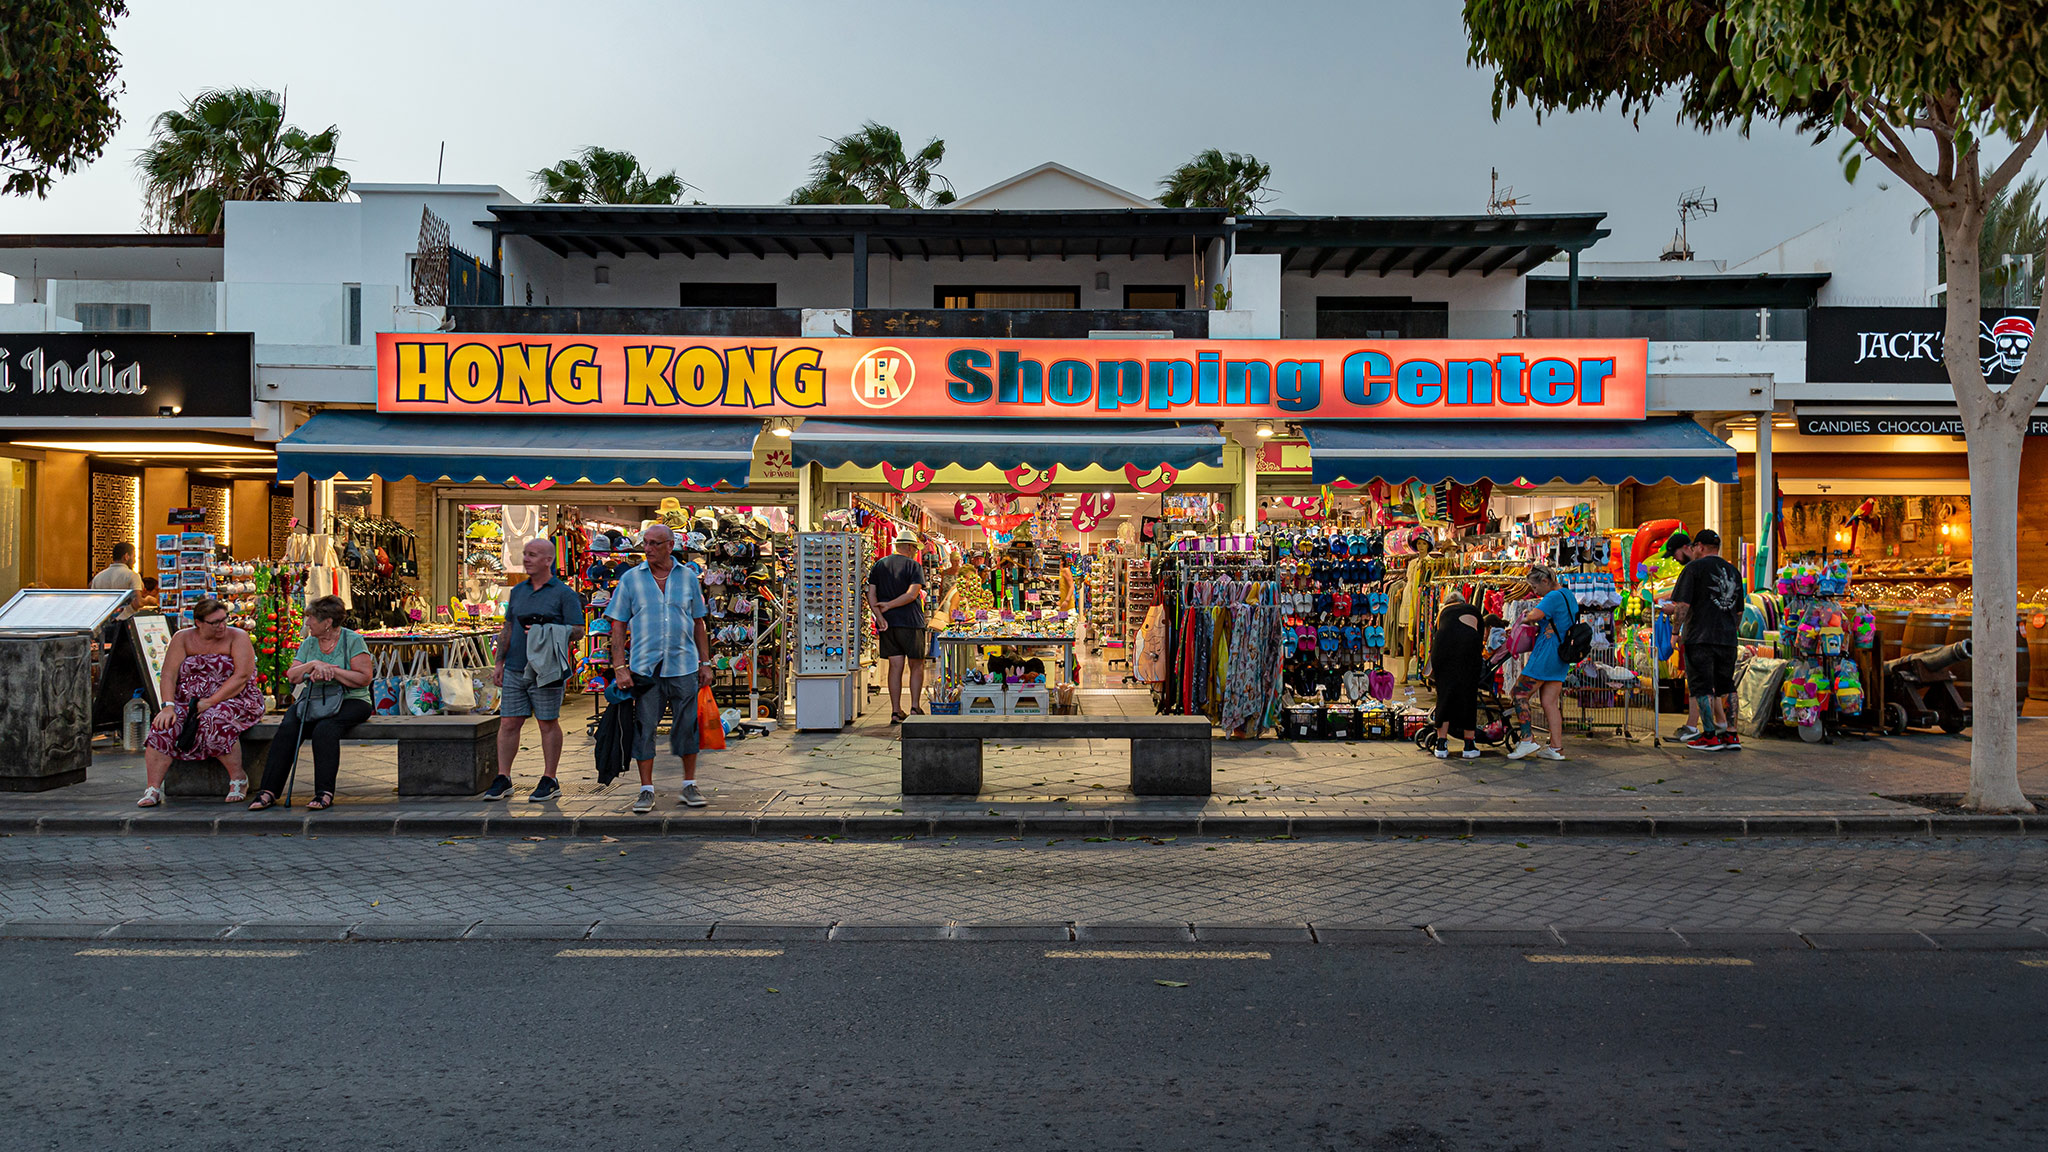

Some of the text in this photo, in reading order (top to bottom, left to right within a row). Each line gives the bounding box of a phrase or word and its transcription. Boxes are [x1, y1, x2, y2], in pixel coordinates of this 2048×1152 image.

[20, 346, 148, 395] India
[395, 342, 827, 408] HONG KONG
[945, 347, 1616, 413] Shopping Center
[1808, 420, 1871, 433] CANDIES
